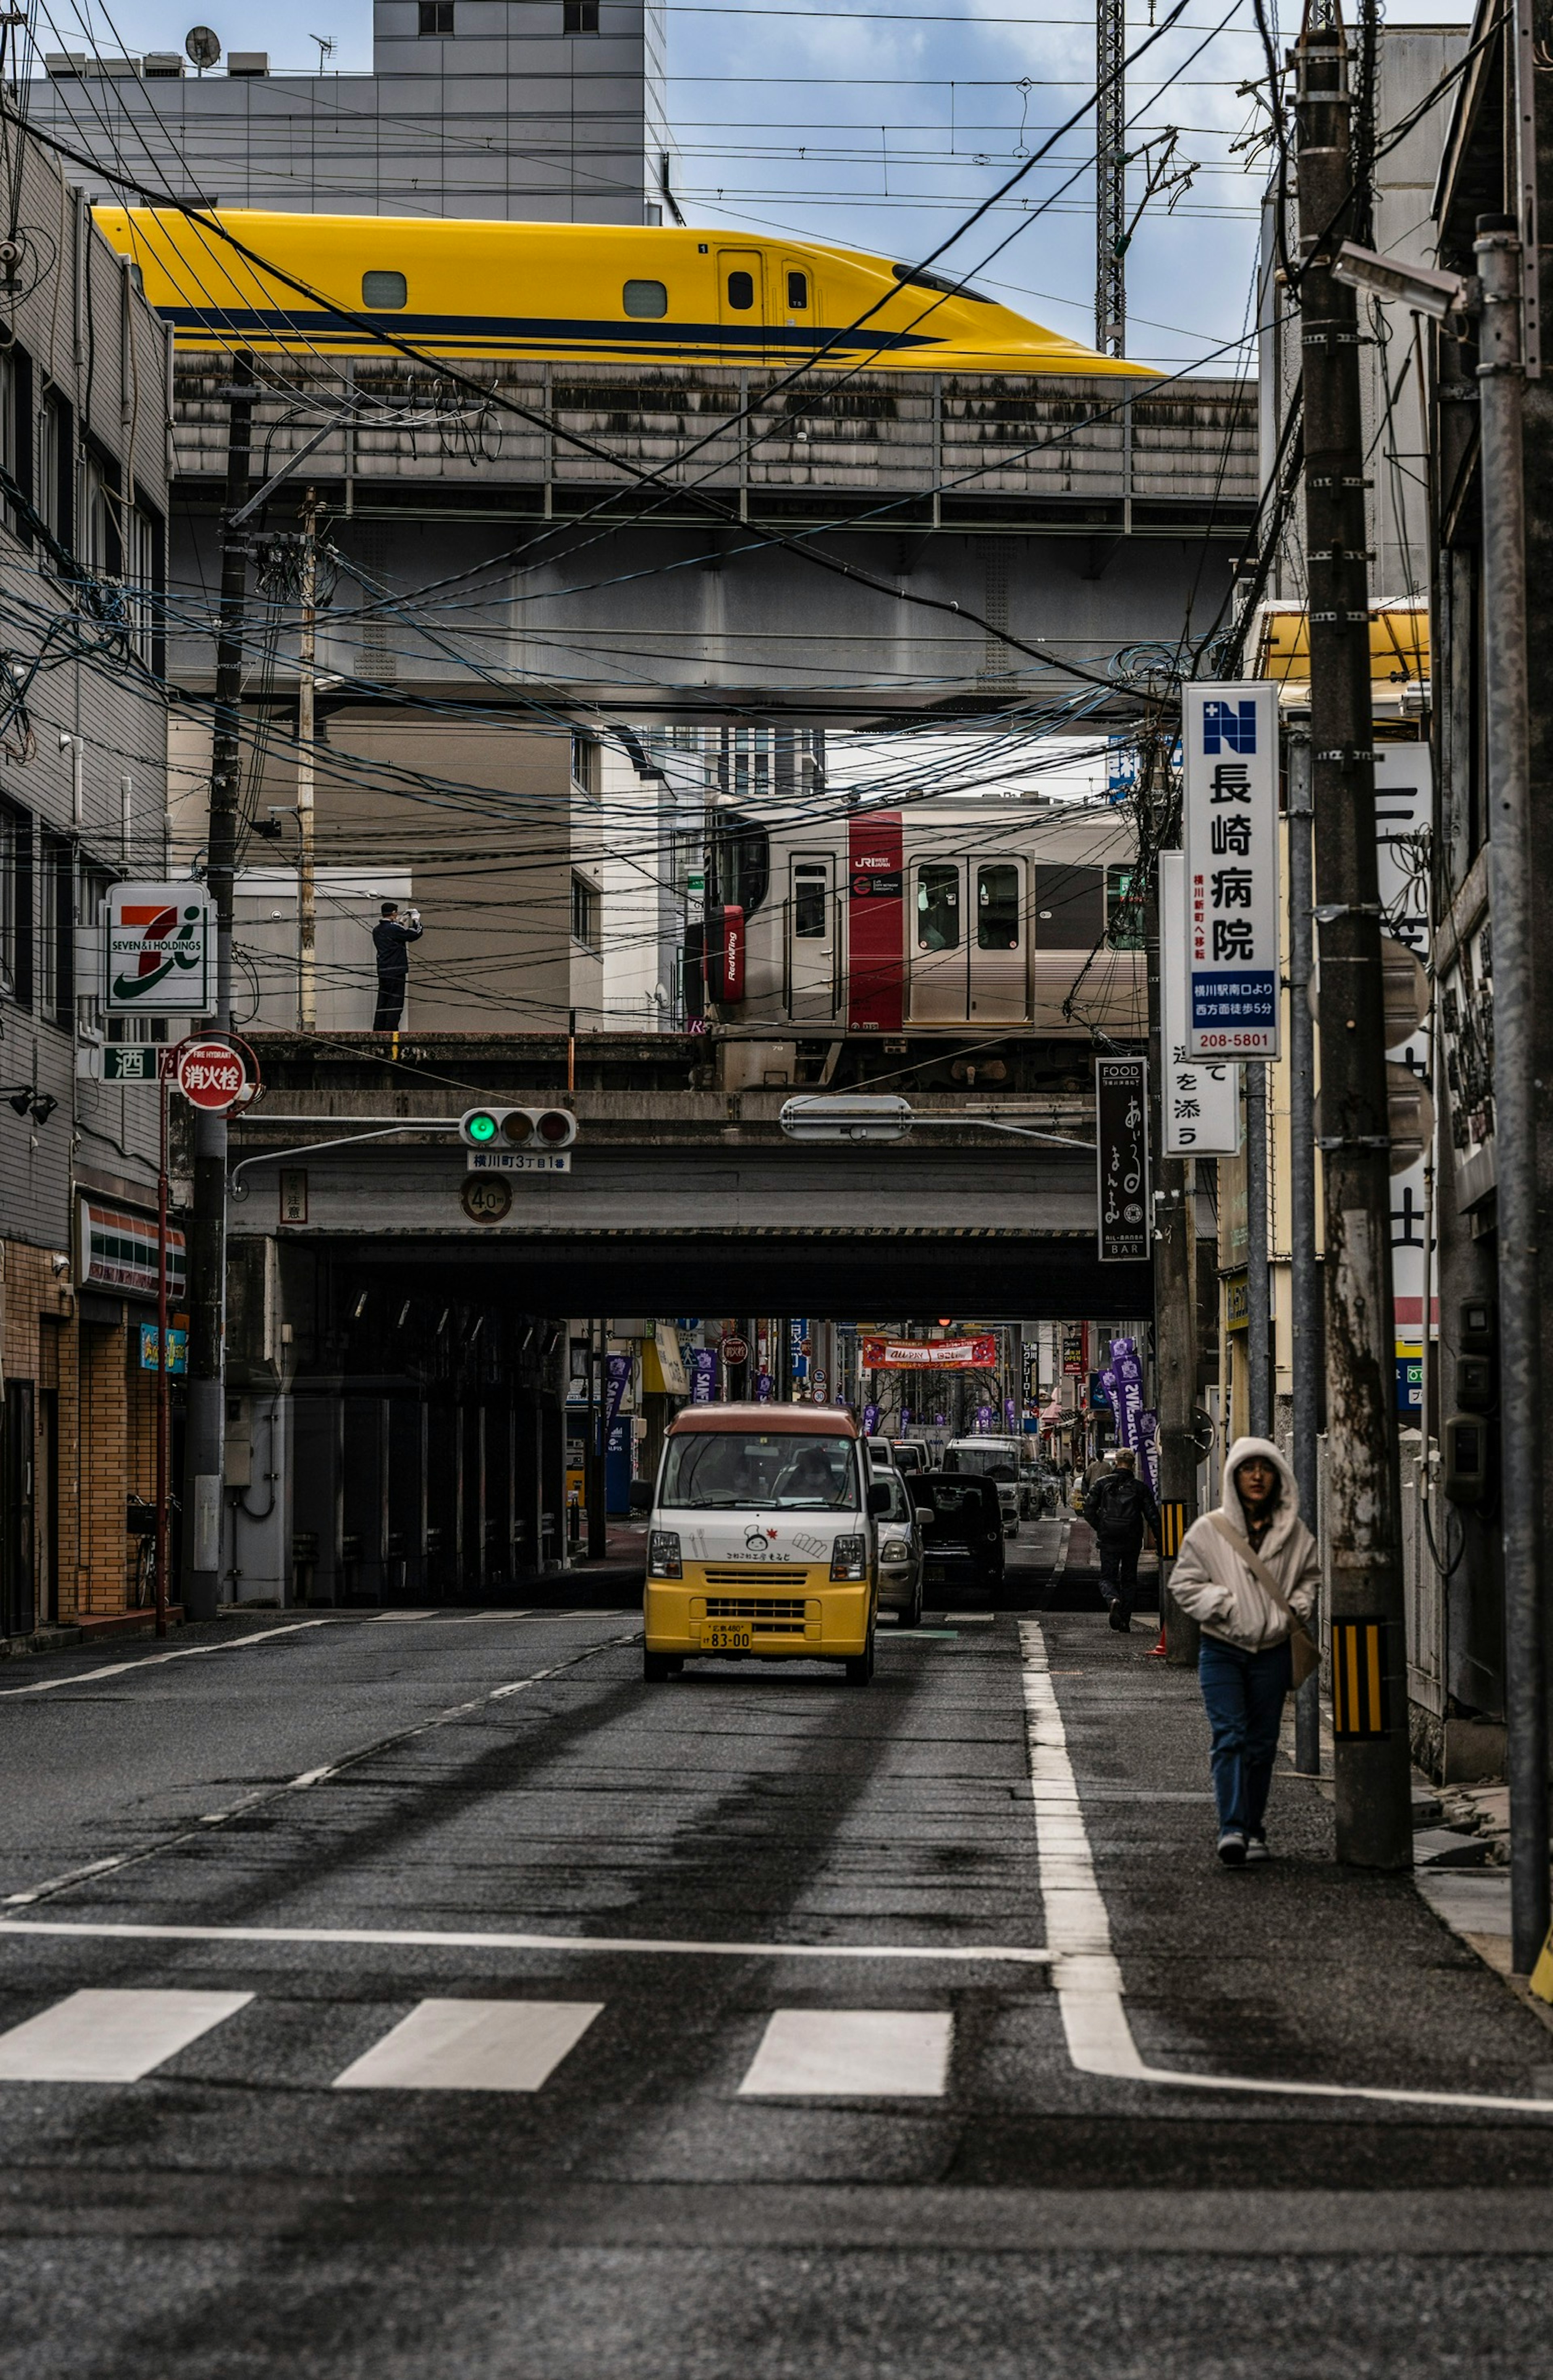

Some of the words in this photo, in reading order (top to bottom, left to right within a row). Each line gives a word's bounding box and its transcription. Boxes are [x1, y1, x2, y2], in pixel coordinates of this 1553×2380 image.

[855, 858, 871, 867] JR
[1210, 763, 1253, 962] 長崎病院
[1194, 874, 1205, 960] 横川新町へ移転
[154, 940, 201, 952] HOLDINGS
[1194, 983, 1273, 997] 横川駅南口より
[1195, 1003, 1272, 1016] 西方面徒歩5分
[1200, 1034, 1268, 1048] 208-5801
[193, 1051, 205, 1059] FIRE
[206, 1051, 232, 1059] HYDRANT
[115, 1048, 145, 1079] 酒
[184, 1064, 240, 1091] 消火栓
[1103, 1066, 1139, 1077] FOOD
[474, 1154, 565, 1169] 横川町3丁目1番
[1111, 1244, 1138, 1254] BAR
[711, 1633, 749, 1647] 83-00
